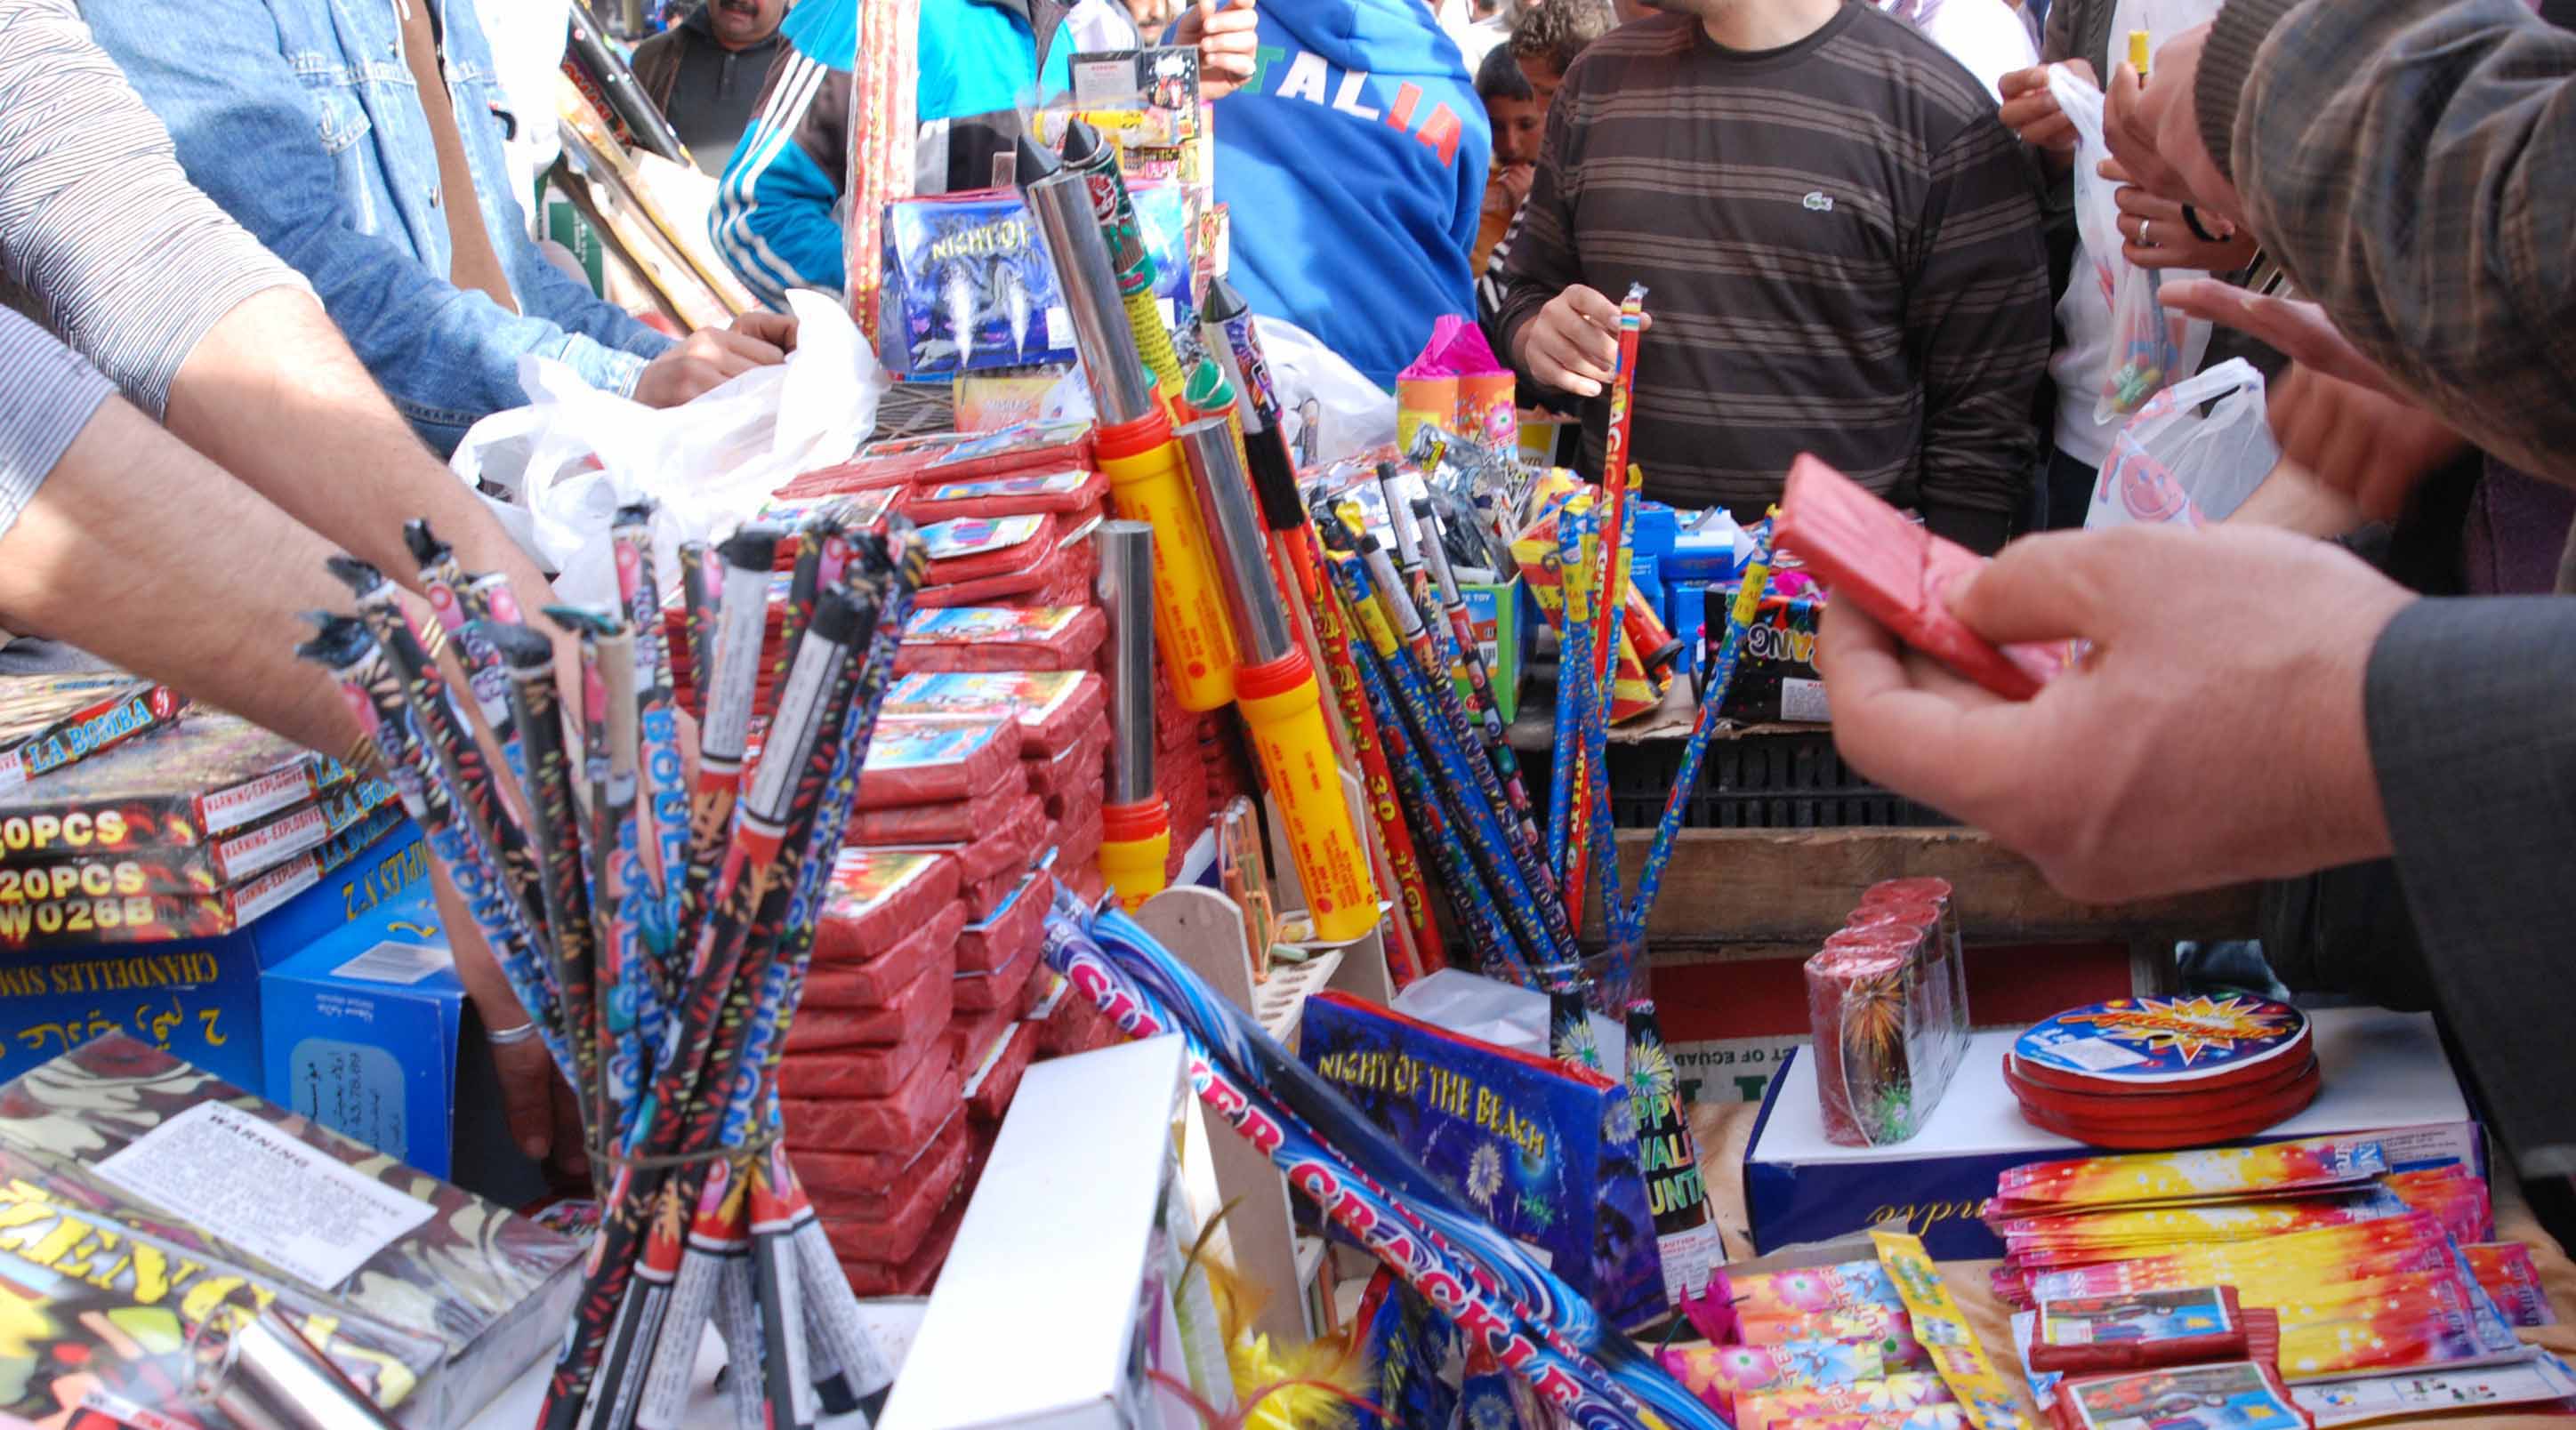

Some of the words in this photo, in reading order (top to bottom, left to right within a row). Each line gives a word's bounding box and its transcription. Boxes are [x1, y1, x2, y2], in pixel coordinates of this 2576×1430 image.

[1244, 44, 1461, 167] TALIA
[932, 227, 994, 261] NIGHT
[28, 736, 67, 773] LA
[68, 697, 153, 755] BOMBA
[312, 757, 345, 788] LA
[326, 790, 356, 828] LA
[1368, 775, 1397, 823] 30
[0, 860, 146, 900] 20PCS
[53, 952, 219, 993] CHANDELLES
[198, 1008, 228, 1046] 2
[1673, 1051, 1735, 1067] ECUAD
[1741, 1048, 1766, 1064] OF
[1317, 1050, 1387, 1089] NIGHT
[1393, 1052, 1422, 1095] OF
[1429, 1064, 1471, 1118] THE
[1476, 1083, 1546, 1156] BEACH
[1630, 1091, 1685, 1130] PPY
[209, 1113, 310, 1169] WARNING
[1647, 1167, 1708, 1217] UNTA
[1289, 1161, 1585, 1421] CRACKLE
